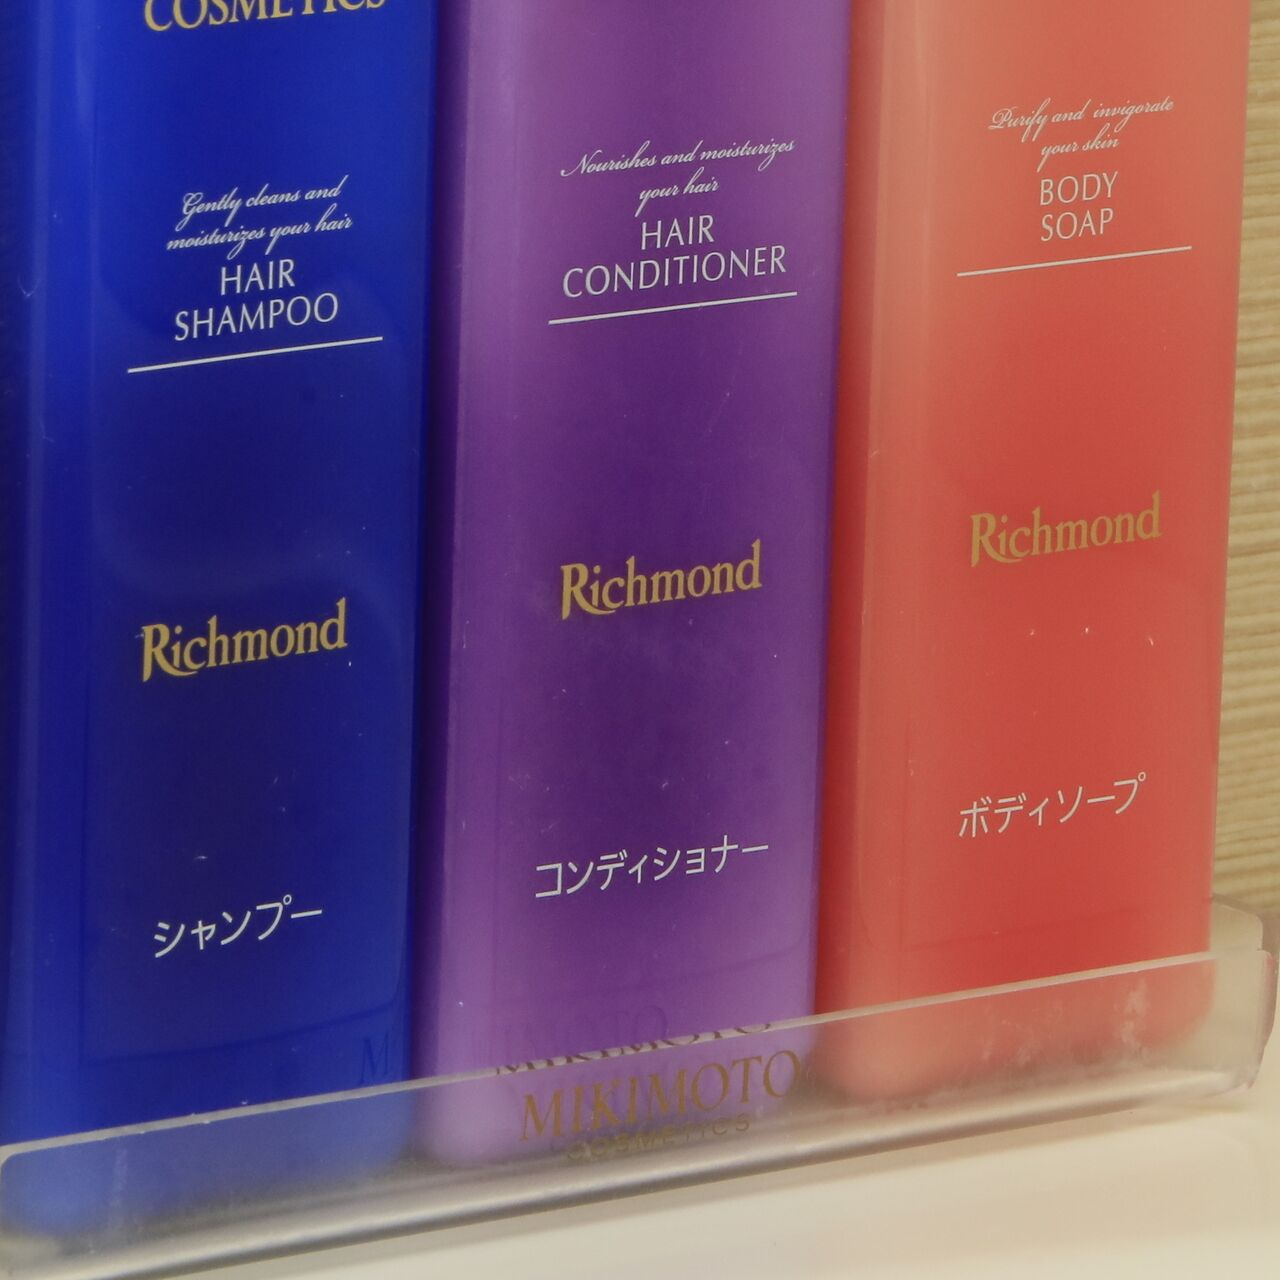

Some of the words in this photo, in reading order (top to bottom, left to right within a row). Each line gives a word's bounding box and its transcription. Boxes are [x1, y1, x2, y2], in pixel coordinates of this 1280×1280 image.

[987, 97, 1051, 143] Purify
[1051, 98, 1092, 123] and
[1093, 95, 1175, 133] invigorate
[560, 139, 658, 177] Nourishes
[660, 139, 704, 165] and
[699, 137, 797, 172] moisturizes
[1036, 142, 1080, 173] your
[1081, 122, 1120, 152] skin
[174, 186, 242, 232] Gently
[245, 183, 301, 209] cleans
[303, 174, 350, 201] and
[634, 184, 680, 218] your
[682, 166, 720, 195] hair
[1039, 170, 1119, 206] BODY
[165, 224, 267, 260] moisturizes
[264, 221, 313, 255] your
[313, 202, 354, 232] hair
[640, 214, 715, 250] HAIR
[1040, 207, 1115, 242] SOAP
[219, 257, 297, 296] HAIR
[562, 245, 787, 298] CONDITIONER
[173, 291, 339, 342] SHAMPOO
[969, 489, 1163, 568] Richmond
[559, 538, 763, 621] Richmond
[140, 596, 348, 683] Richmond
[957, 771, 1147, 839] ボディソープ
[534, 833, 770, 899] コンディショナー
[153, 893, 323, 959] シャンプー
[520, 1049, 803, 1142] MIKIMOTO
